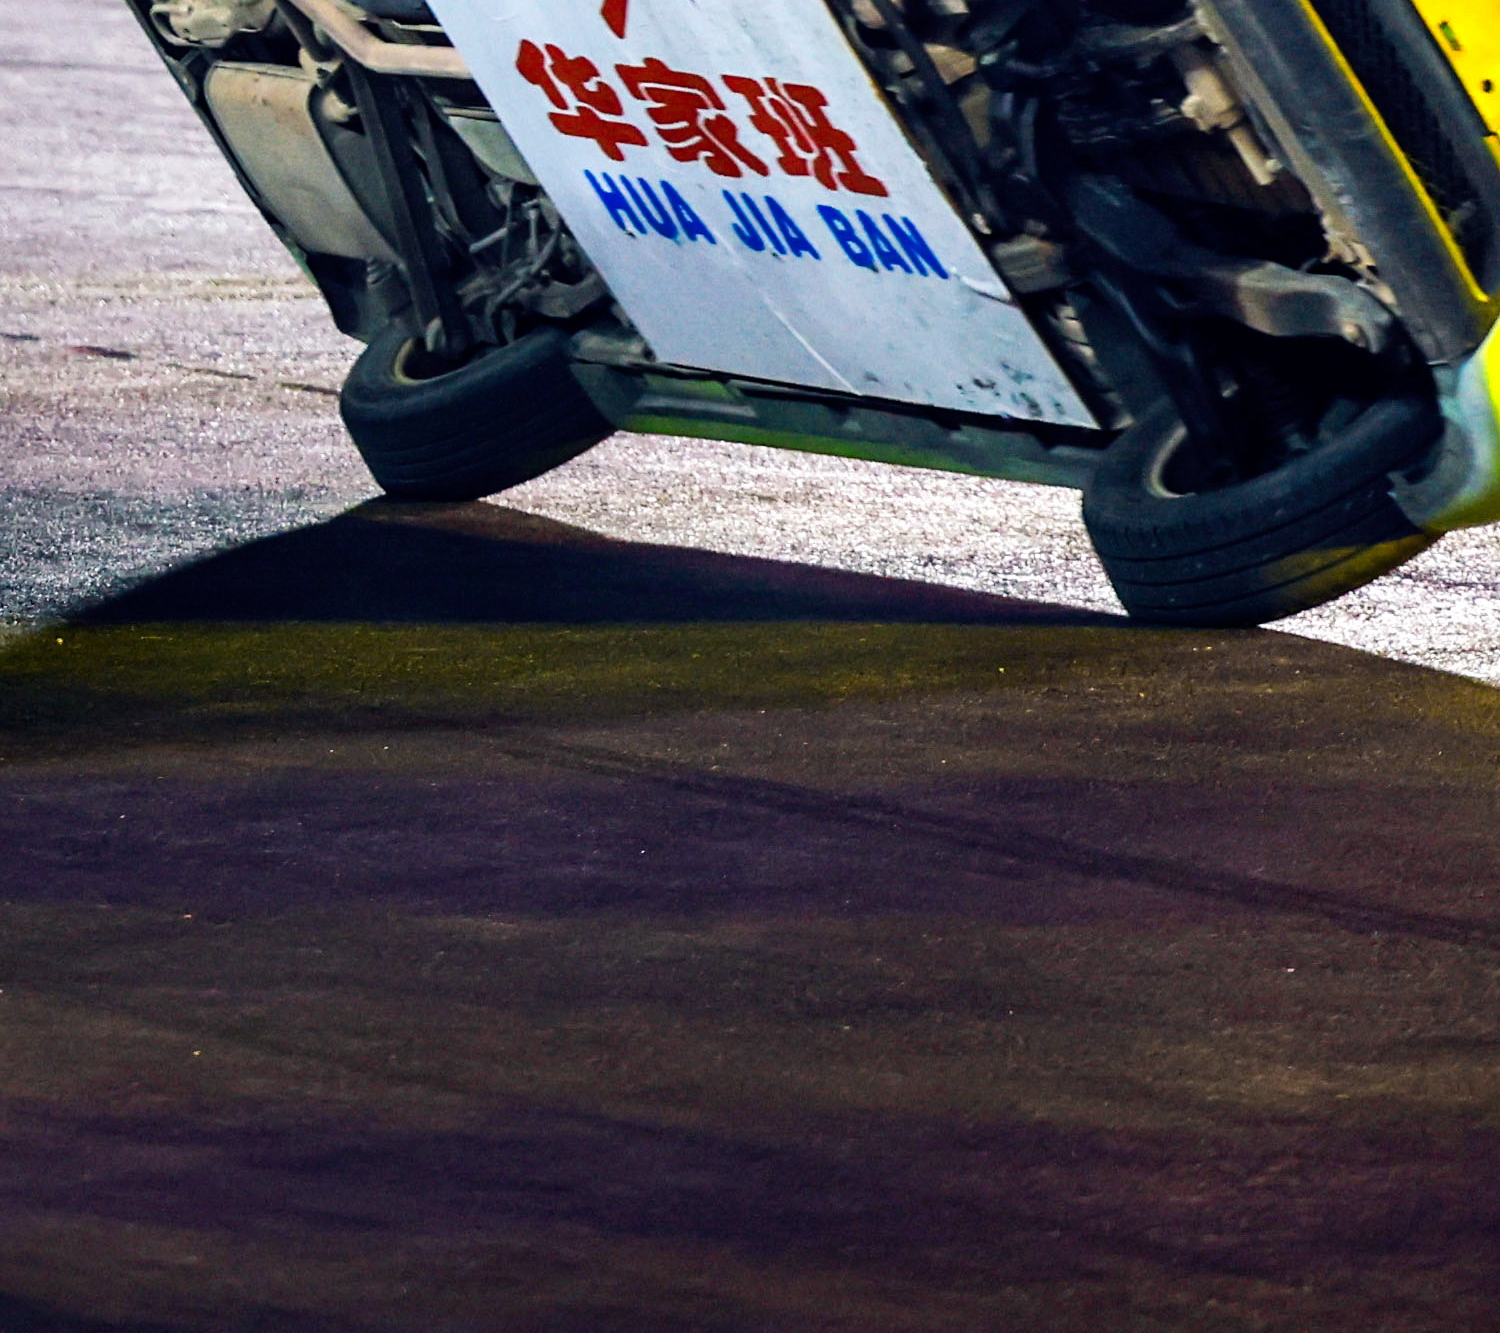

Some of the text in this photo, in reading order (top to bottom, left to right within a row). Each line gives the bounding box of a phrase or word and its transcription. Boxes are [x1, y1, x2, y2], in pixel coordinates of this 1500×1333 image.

[515, 39, 888, 197] 华家班
[584, 169, 949, 279] HUA JIA BAN
